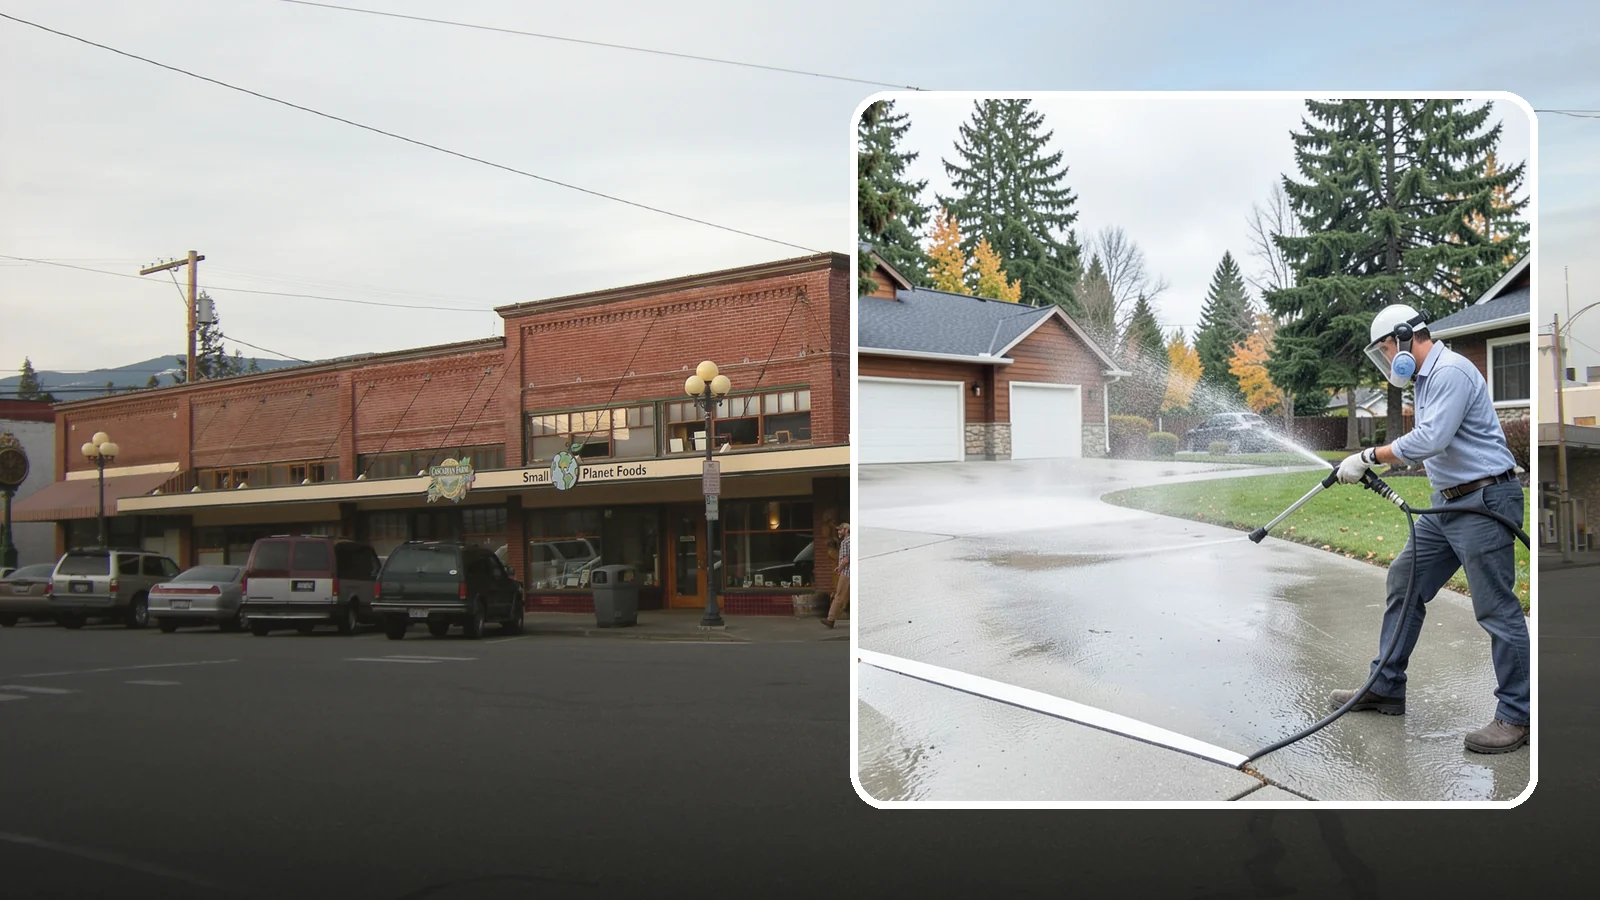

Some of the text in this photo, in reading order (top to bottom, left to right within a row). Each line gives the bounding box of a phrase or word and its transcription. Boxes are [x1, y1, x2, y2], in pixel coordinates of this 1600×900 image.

[523, 464, 647, 483] Small Planet Foods
